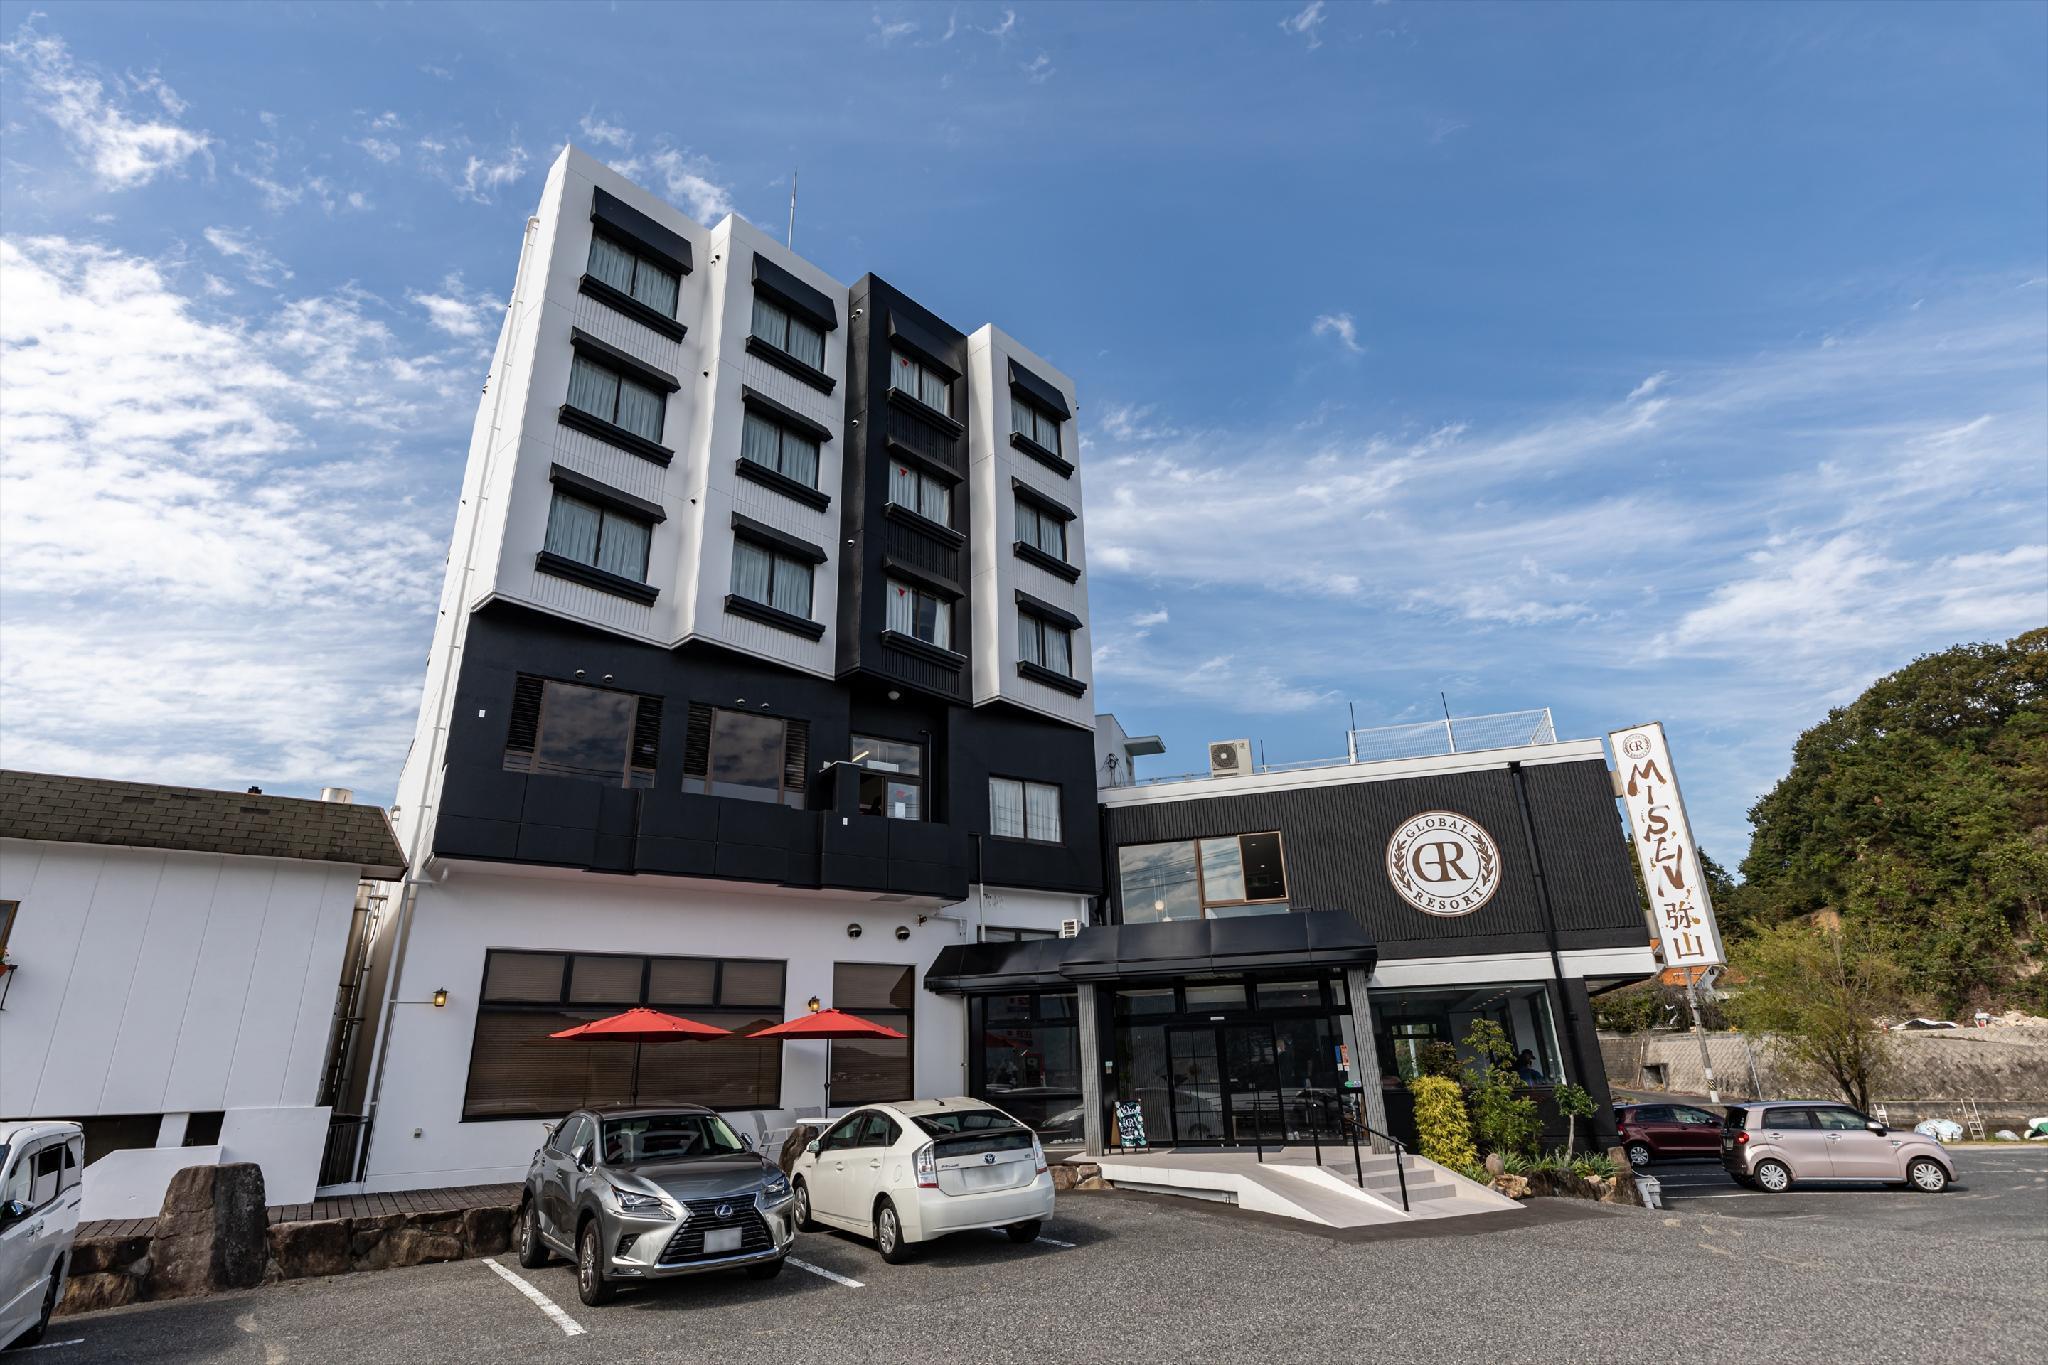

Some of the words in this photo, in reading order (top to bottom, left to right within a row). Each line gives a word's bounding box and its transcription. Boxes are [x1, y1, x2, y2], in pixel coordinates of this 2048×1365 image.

[1405, 817, 1470, 838] GLOBAL
[1627, 759, 1684, 897] MISEN
[1413, 886, 1484, 910] RESORT
[1664, 902, 1705, 958] 弥山
